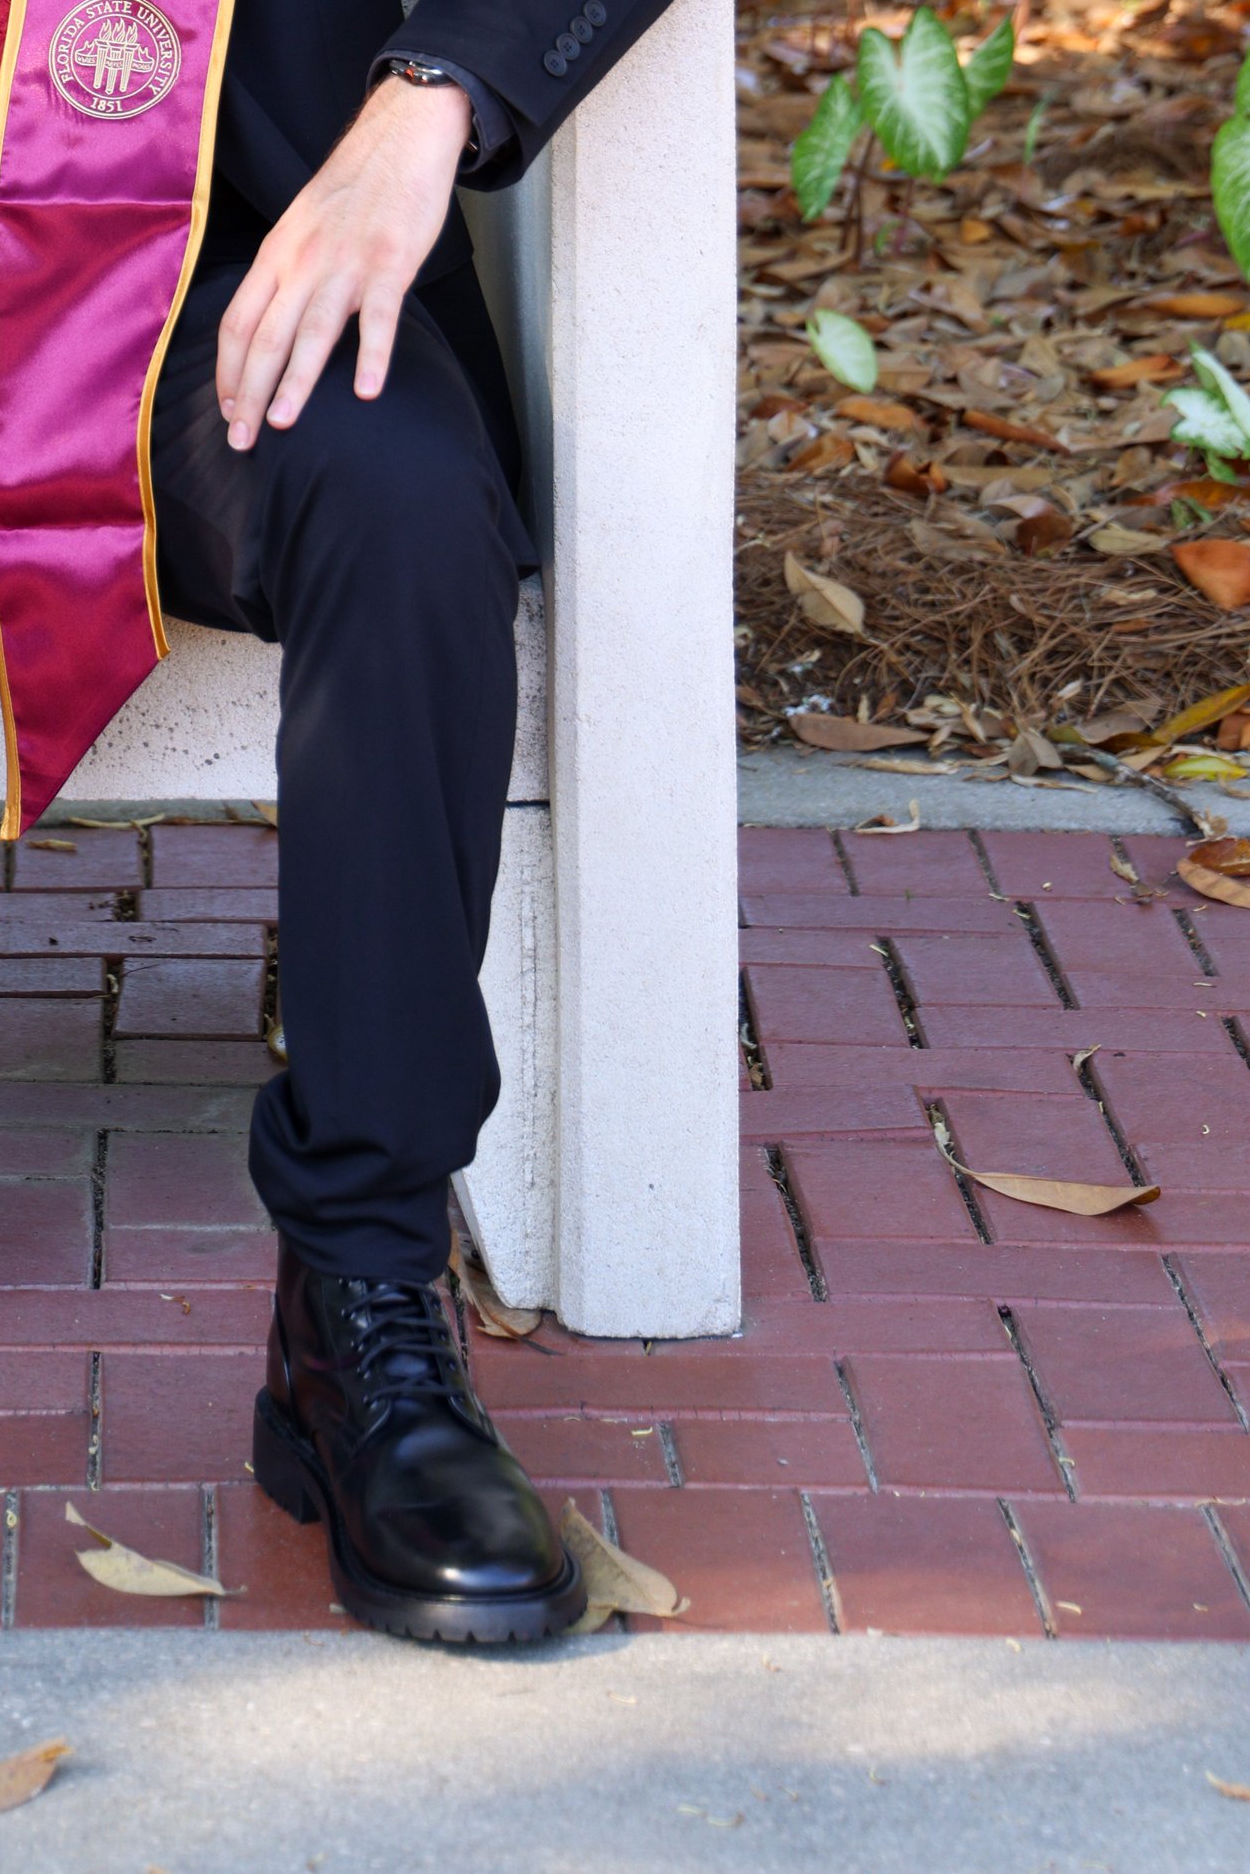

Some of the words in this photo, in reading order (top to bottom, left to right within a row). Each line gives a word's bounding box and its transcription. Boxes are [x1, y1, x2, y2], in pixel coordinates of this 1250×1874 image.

[57, 17, 85, 84] FLORIDA
[86, 0, 132, 19] STATE
[137, 6, 173, 95] UNIVERSITY
[90, 97, 123, 113] 1851
